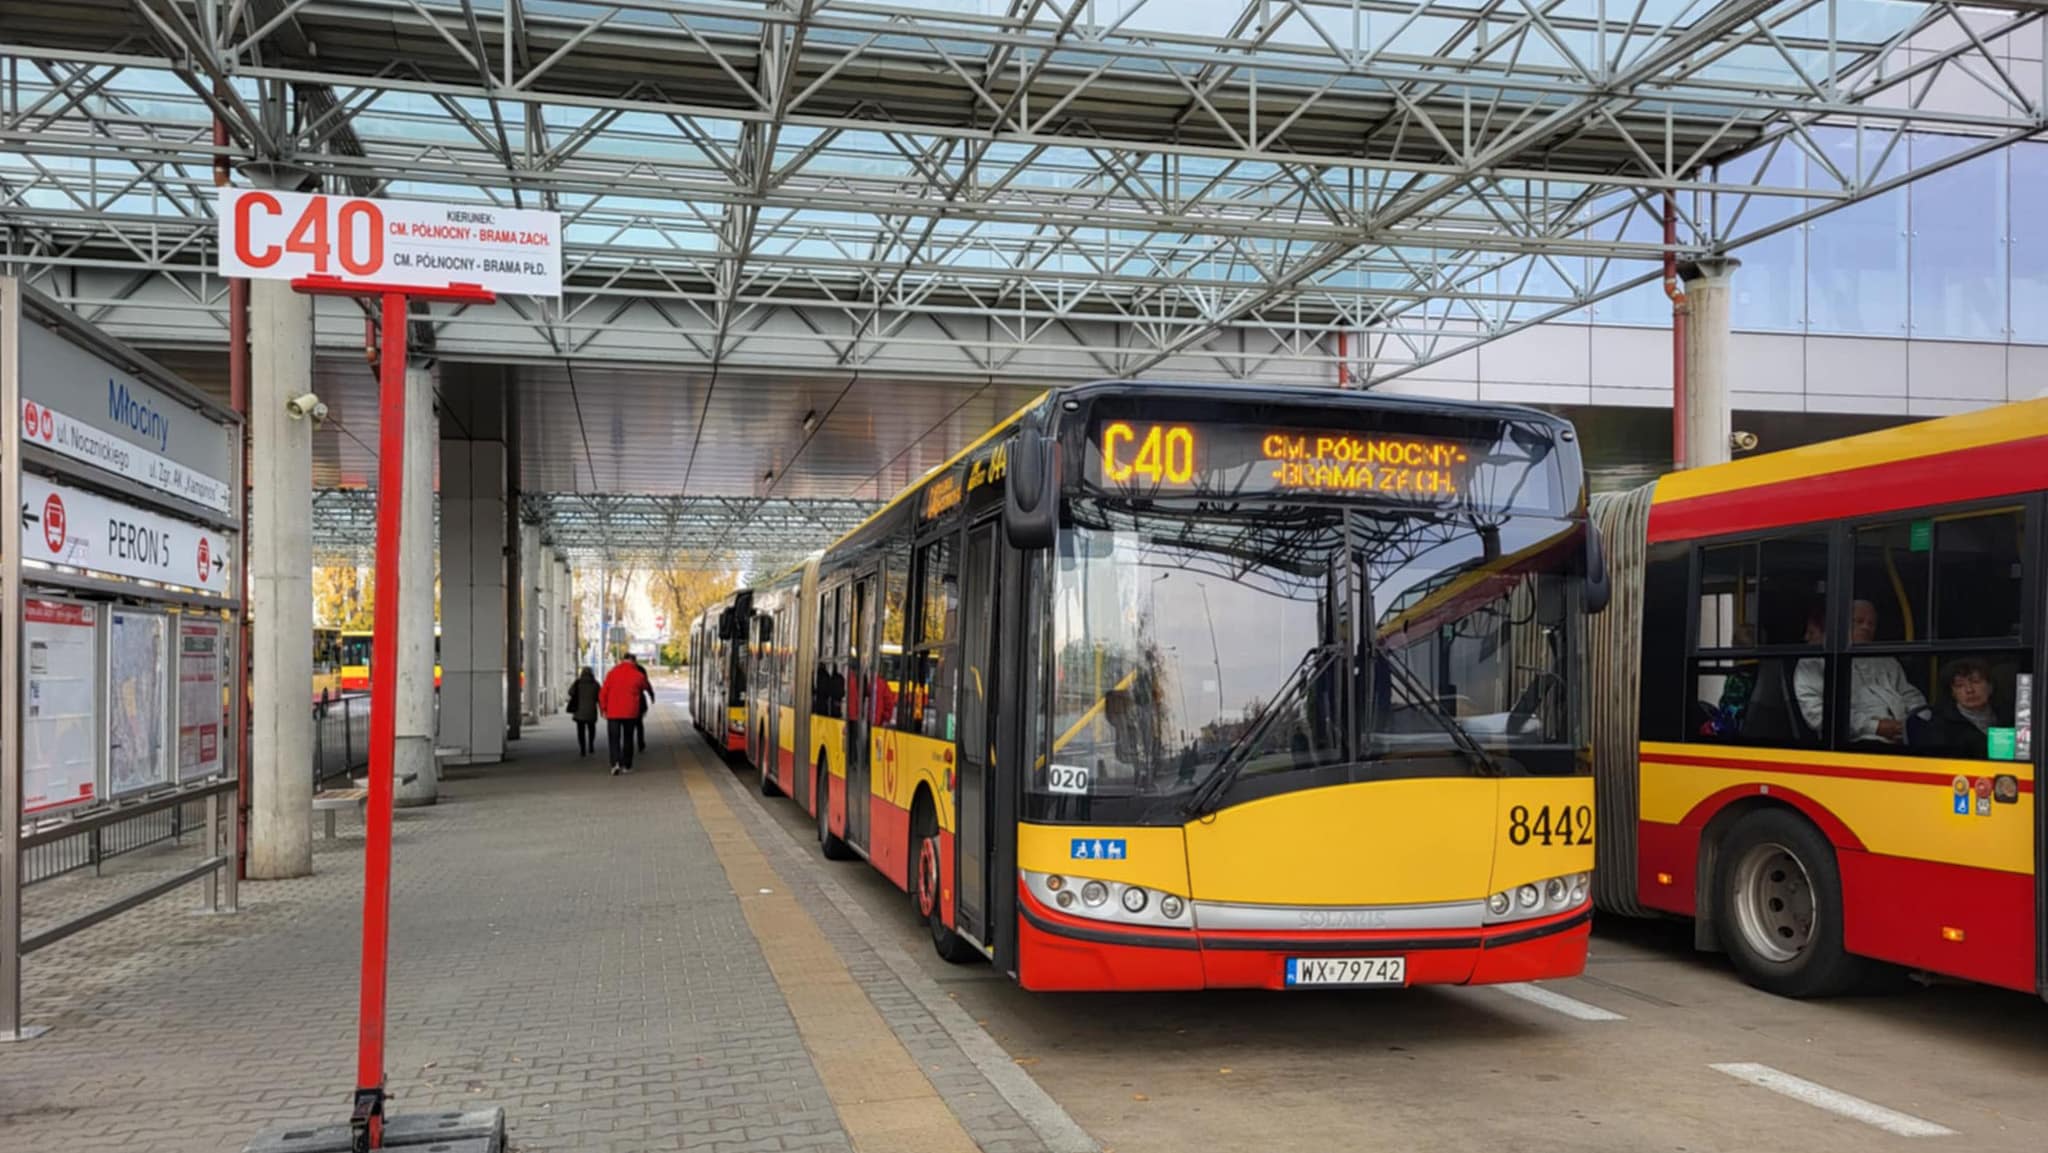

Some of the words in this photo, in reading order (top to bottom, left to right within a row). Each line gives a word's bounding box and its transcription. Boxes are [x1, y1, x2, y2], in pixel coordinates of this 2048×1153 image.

[447, 210, 496, 224] KIERUNEK:
[234, 191, 384, 276] C40
[389, 222, 409, 236] CM.
[411, 222, 471, 240] PÓŁNOCNY
[479, 229, 518, 245] BRAMA
[519, 232, 550, 246] ZACH.
[393, 253, 413, 267] CM.
[416, 252, 475, 271] PÓŁNOCNY
[483, 259, 521, 274] BRAMA
[523, 262, 547, 276] PŁD.
[109, 378, 169, 451] Młociny
[1104, 423, 1193, 484] C40
[1263, 434, 1311, 459] CM.
[1379, 467, 1456, 493] ZACH.
[109, 519, 159, 565] PERON
[162, 534, 170, 568] 5
[1051, 768, 1087, 790] 020
[1508, 804, 1593, 846] 8442
[1298, 911, 1387, 929] SOLARIS
[1302, 961, 1328, 982] WX
[1337, 960, 1400, 982] 79742
